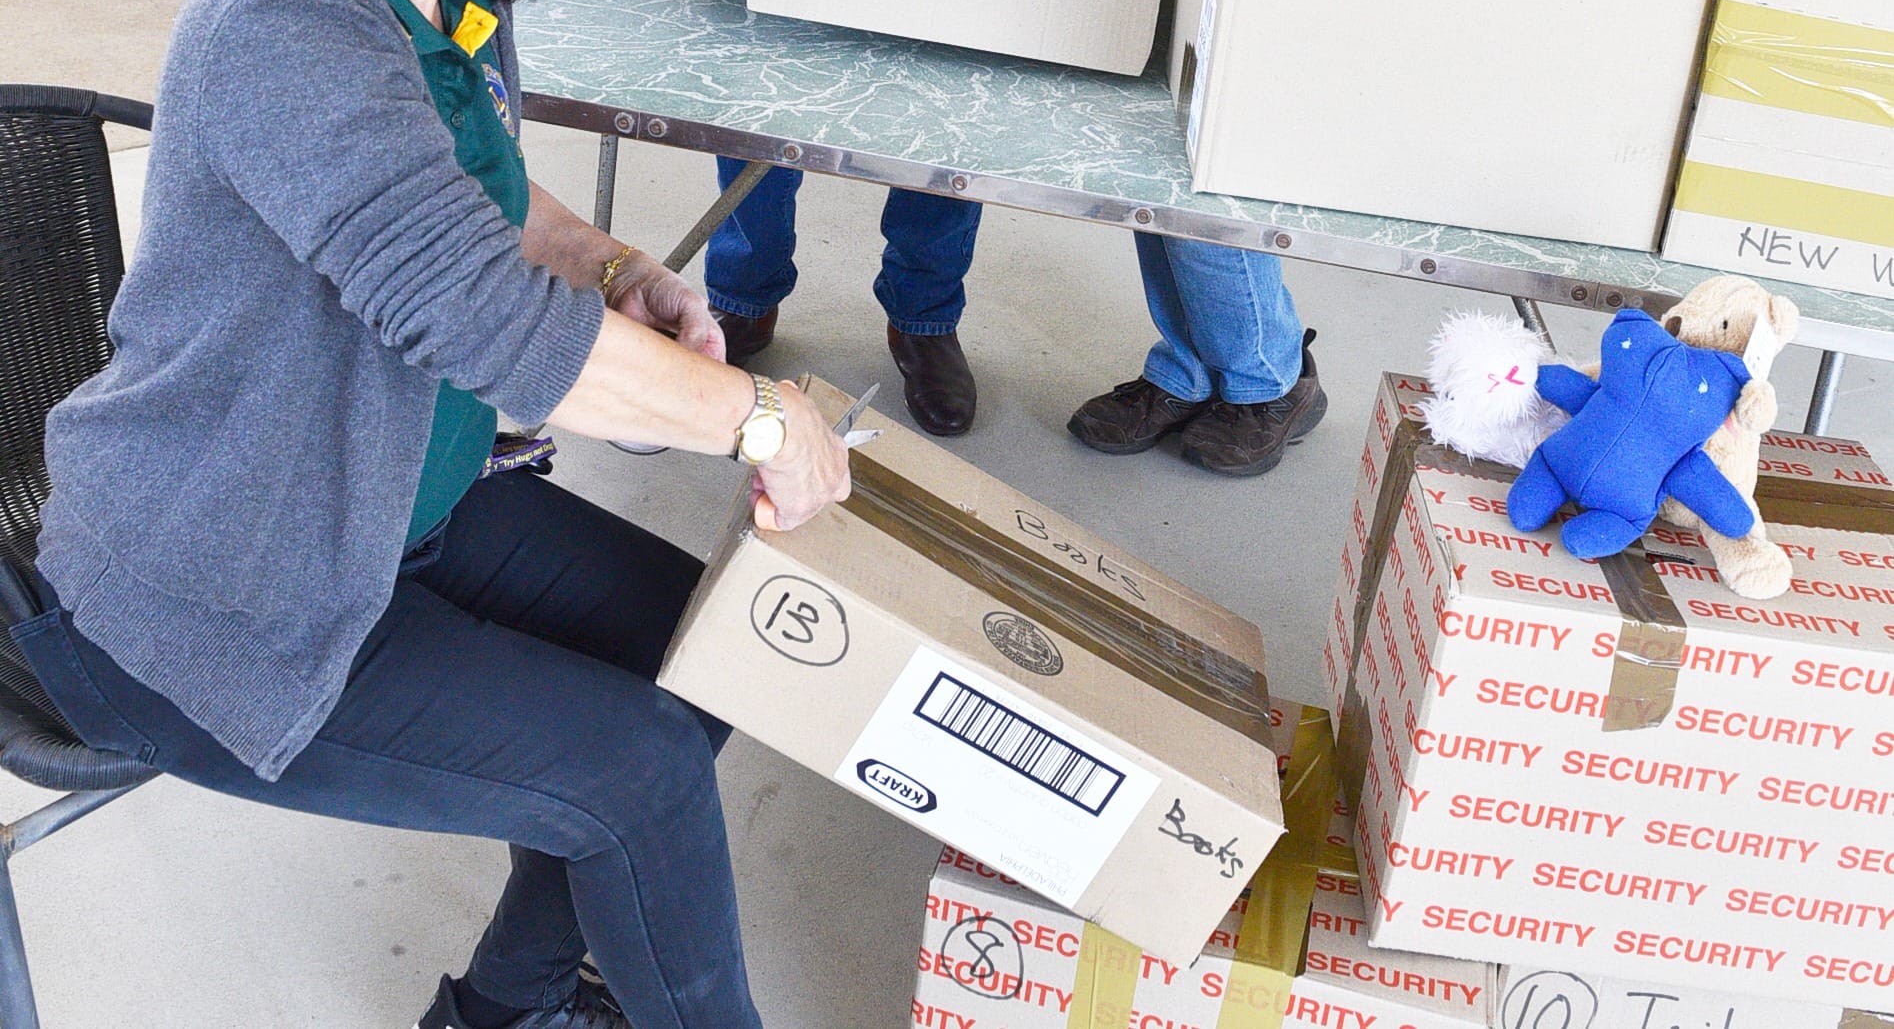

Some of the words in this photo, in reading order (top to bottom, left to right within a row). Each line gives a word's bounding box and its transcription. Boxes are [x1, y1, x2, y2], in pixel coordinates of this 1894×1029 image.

[1738, 226, 1839, 270] NEW
[515, 452, 533, 463] Hugs
[1015, 509, 1146, 601] Books
[1687, 599, 1860, 637] SECURITY
[1675, 705, 1854, 750] SECURITY
[869, 769, 924, 805] KRAFT
[1561, 750, 1740, 795] SECURITY
[1159, 799, 1244, 878] Books
[1448, 794, 1625, 838] SECURITY
[1643, 820, 1820, 864] SECURITY
[997, 852, 1068, 897] PHILADELPHIA
[1532, 863, 1707, 907] SECURITY
[1725, 888, 1894, 931] SECURITY
[965, 931, 1004, 978] 8
[1422, 905, 1596, 948] SECURITY
[1613, 930, 1787, 973] SECURITY
[918, 947, 1074, 1013] SECURITY
[1307, 951, 1482, 1006] SECURITY
